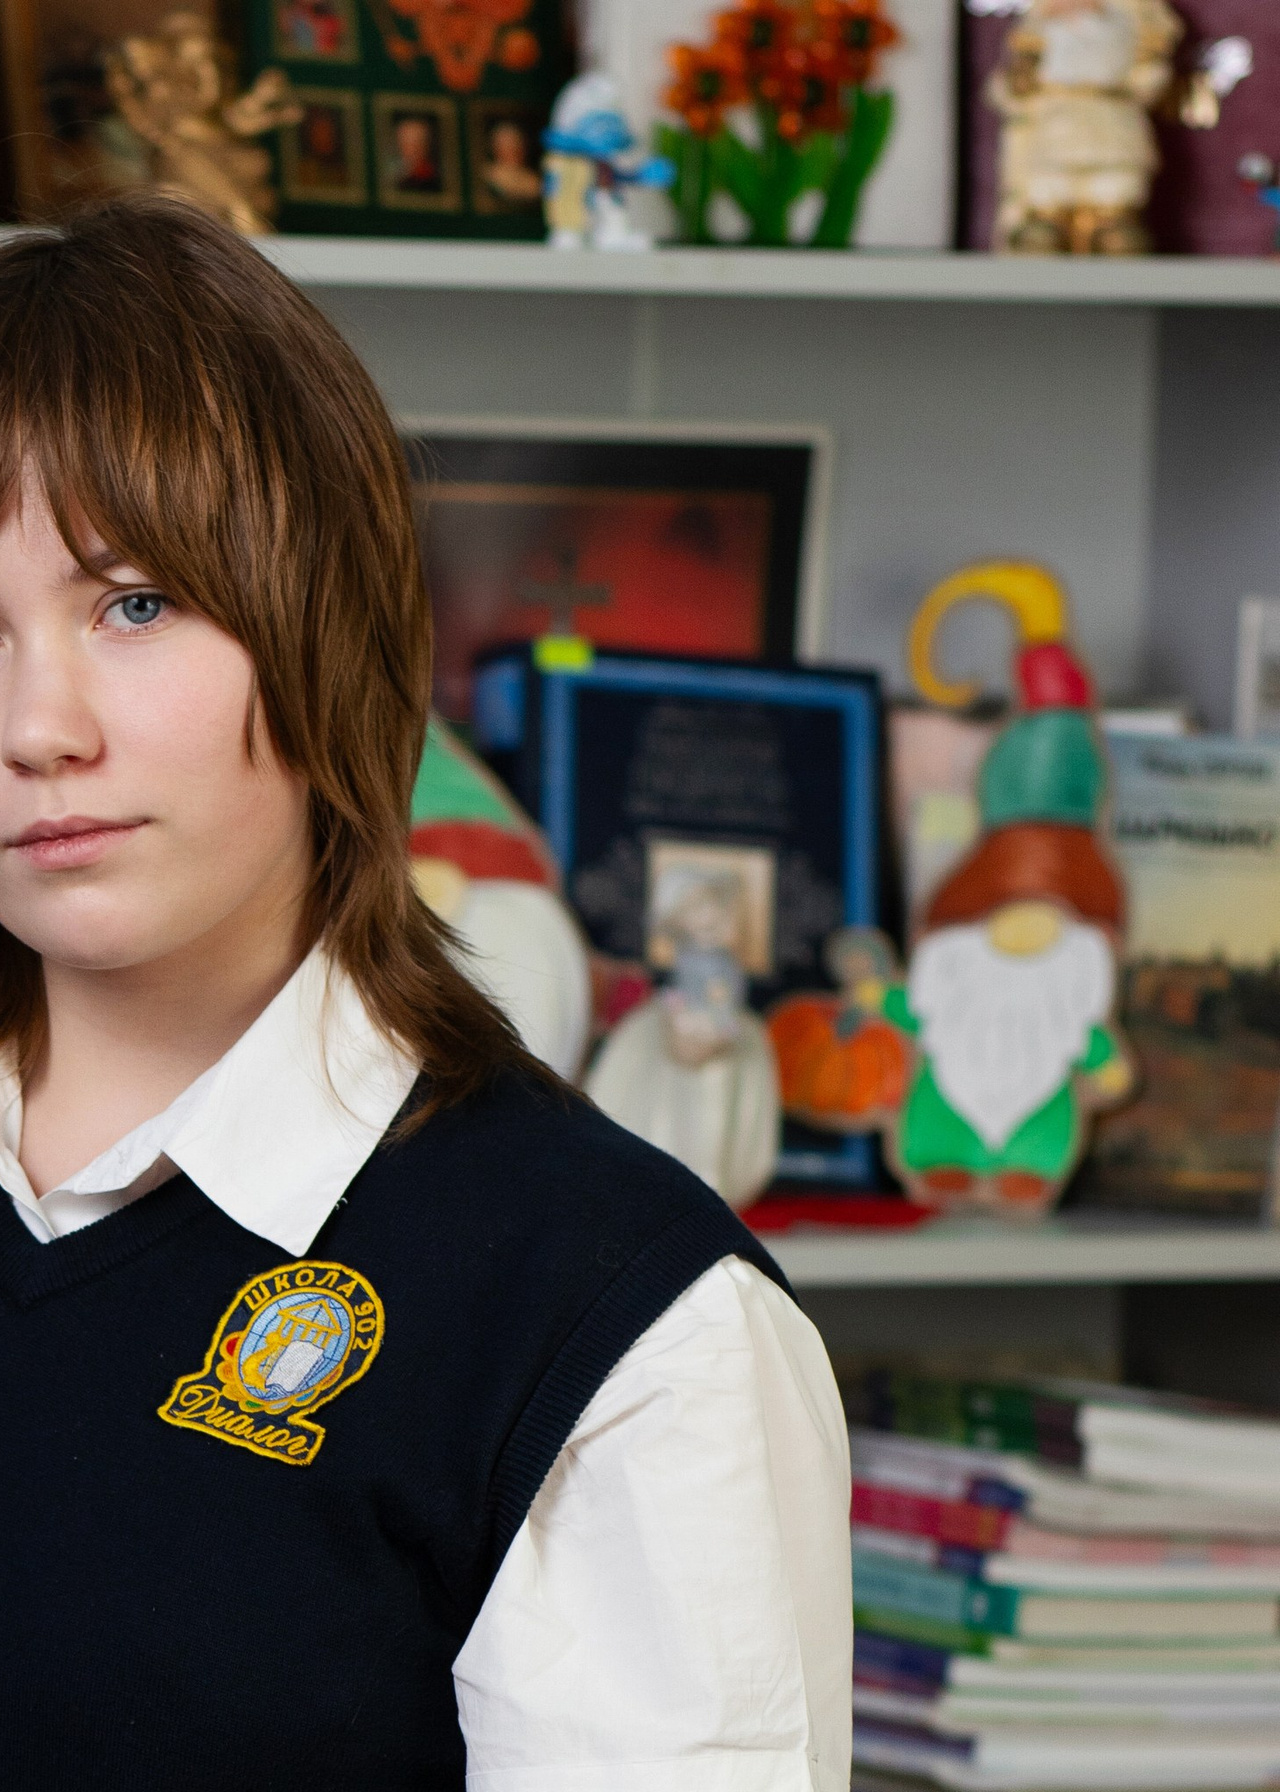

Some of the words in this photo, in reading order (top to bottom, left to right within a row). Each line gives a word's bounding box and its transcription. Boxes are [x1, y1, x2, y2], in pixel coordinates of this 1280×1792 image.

[245, 1269, 358, 1311] ШКОЛА
[352, 1302, 376, 1351] 902
[168, 1385, 310, 1456] Диалог
